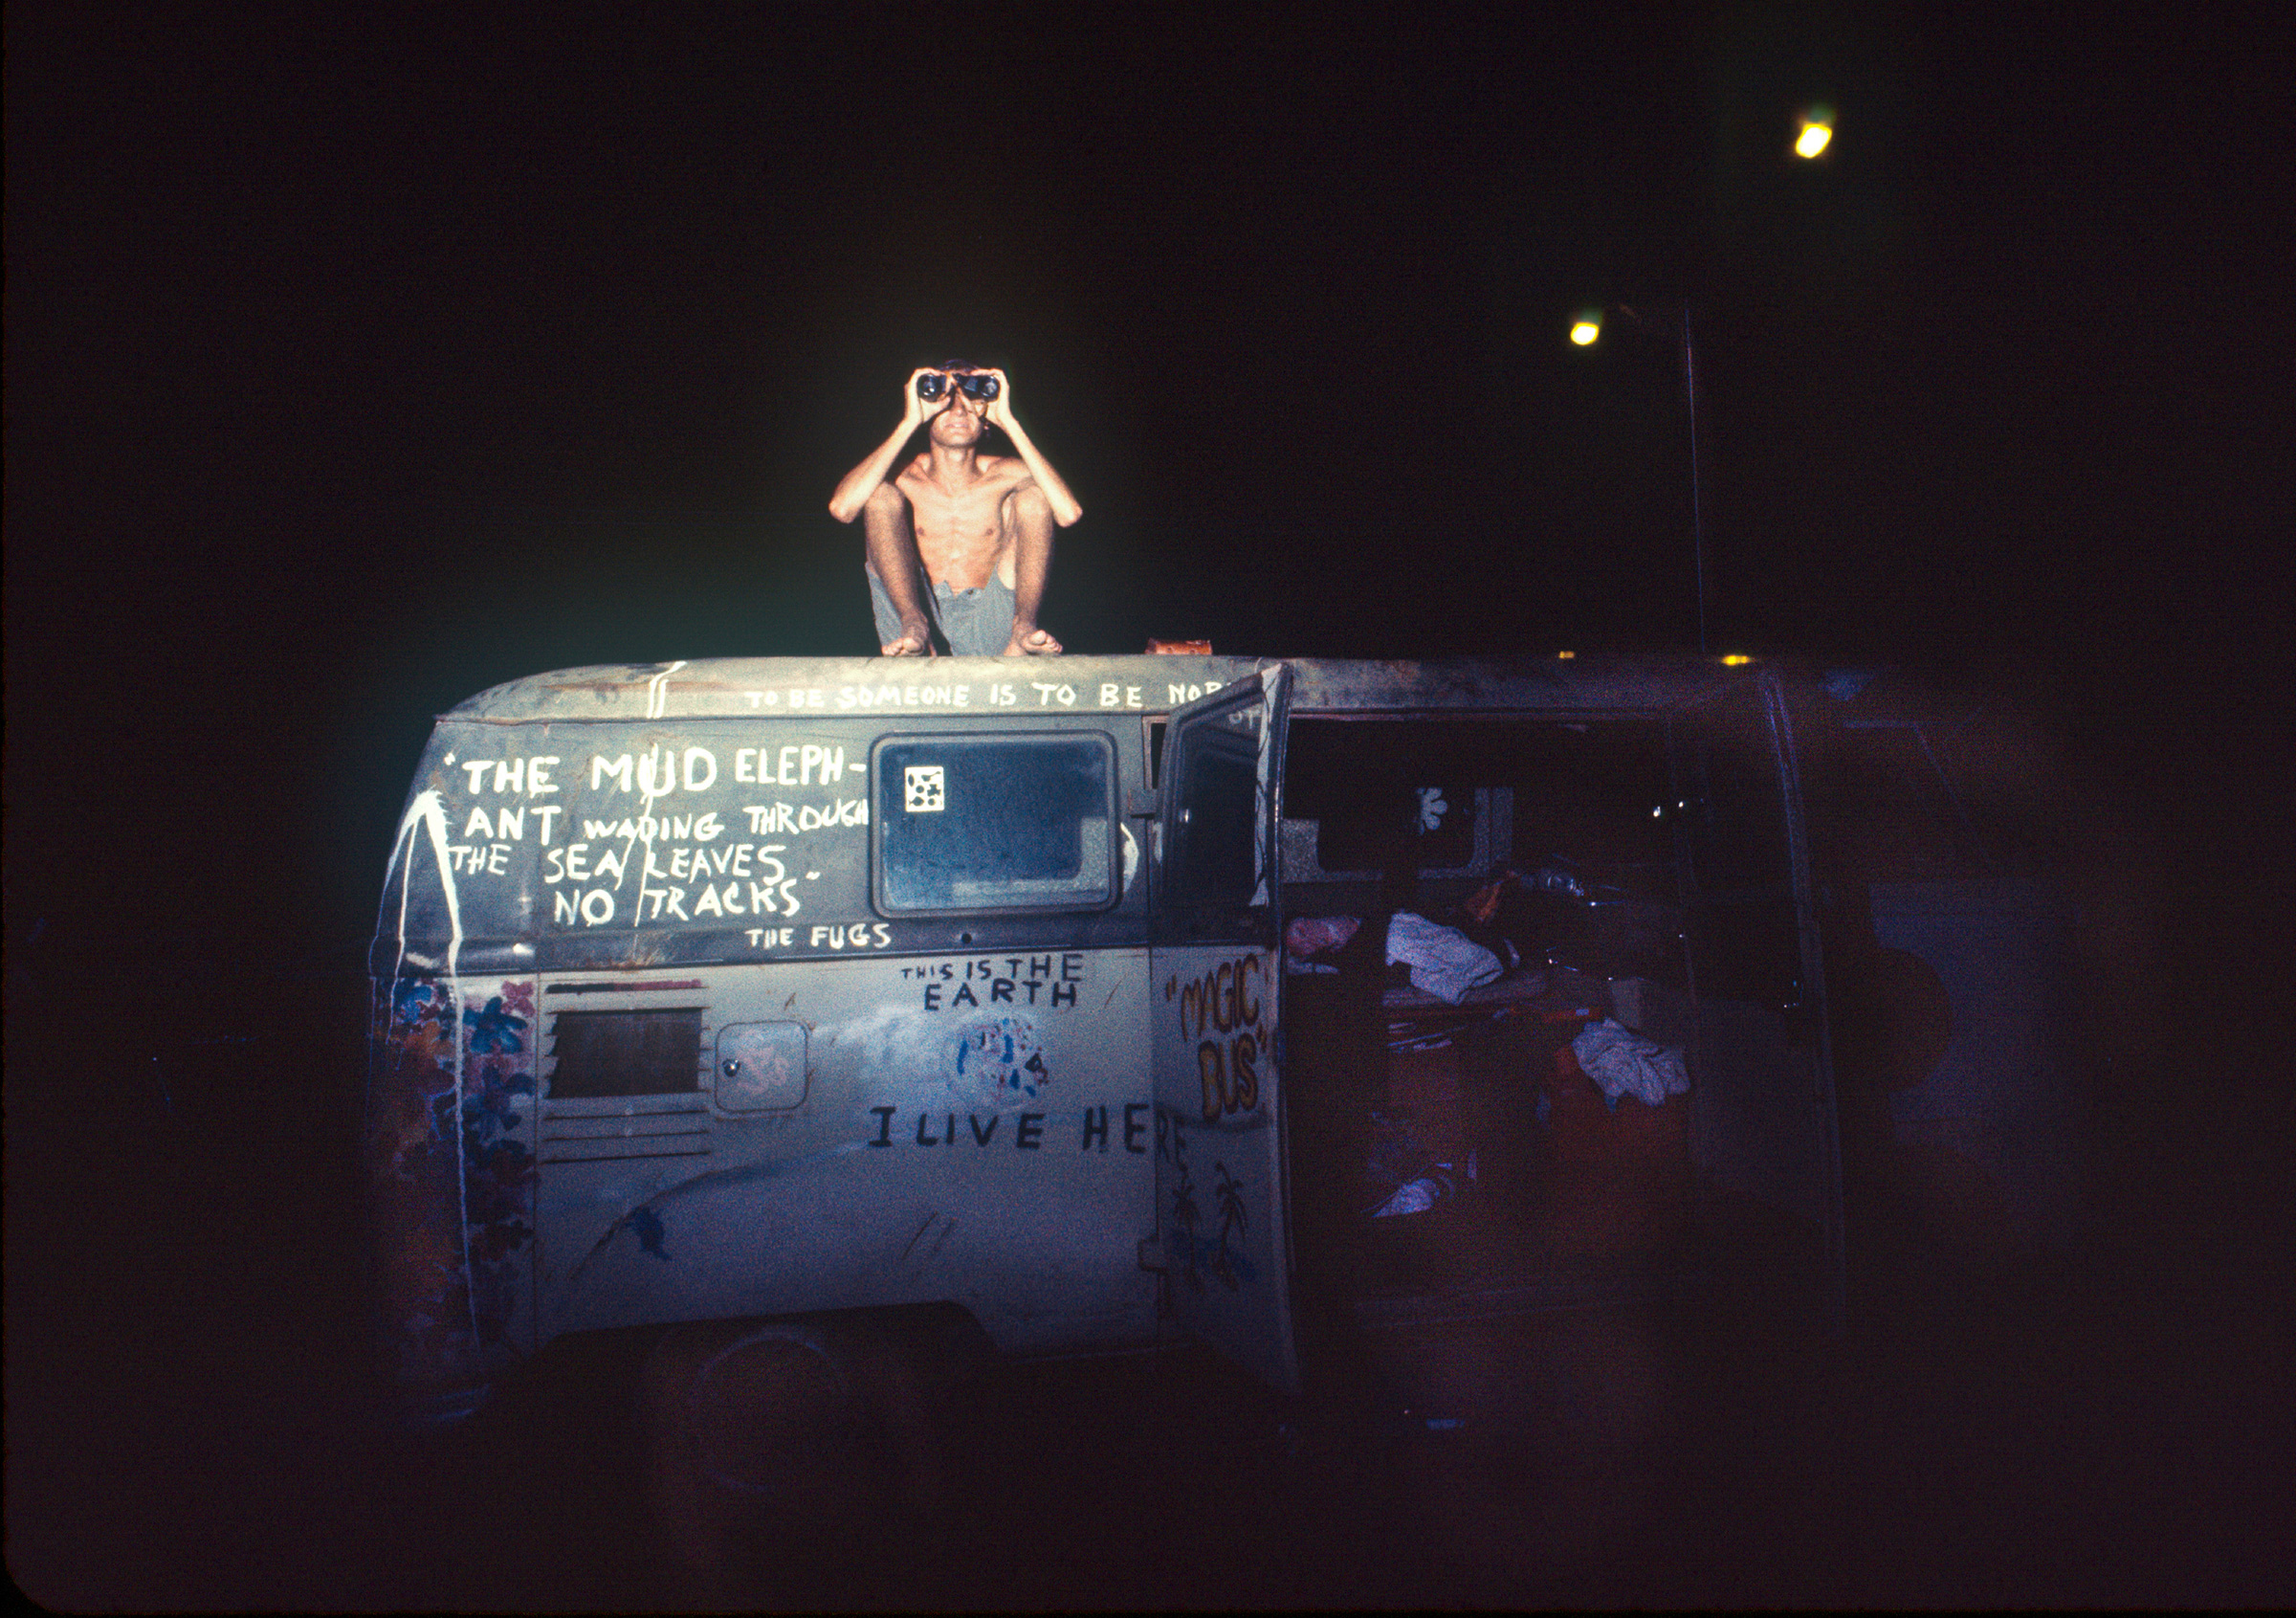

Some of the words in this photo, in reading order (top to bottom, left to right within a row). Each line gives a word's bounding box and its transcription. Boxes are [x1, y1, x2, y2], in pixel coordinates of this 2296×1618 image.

[744, 689, 779, 707] TO
[788, 688, 825, 706] BE
[836, 684, 970, 706] SOMEONE
[989, 683, 1017, 705] IS
[1032, 683, 1076, 706] TO
[1099, 685, 1142, 707] BE
[591, 745, 717, 798] MUD
[465, 806, 561, 845] ANT
[583, 810, 724, 841] WADING
[742, 799, 869, 835] THROUGH
[449, 846, 511, 875] THE
[544, 844, 622, 890] SEA
[645, 844, 786, 882] LEAVES
[554, 889, 614, 926] NO
[744, 928, 793, 946] THE
[810, 924, 892, 946] FUGS
[901, 961, 953, 982] THIS
[966, 959, 991, 980] IS
[1005, 954, 1083, 982] THE
[923, 977, 1077, 1011] EARTH
[869, 1106, 896, 1147] I
[916, 1113, 1046, 1149] LIVE
[1083, 1103, 1187, 1169] HERE
